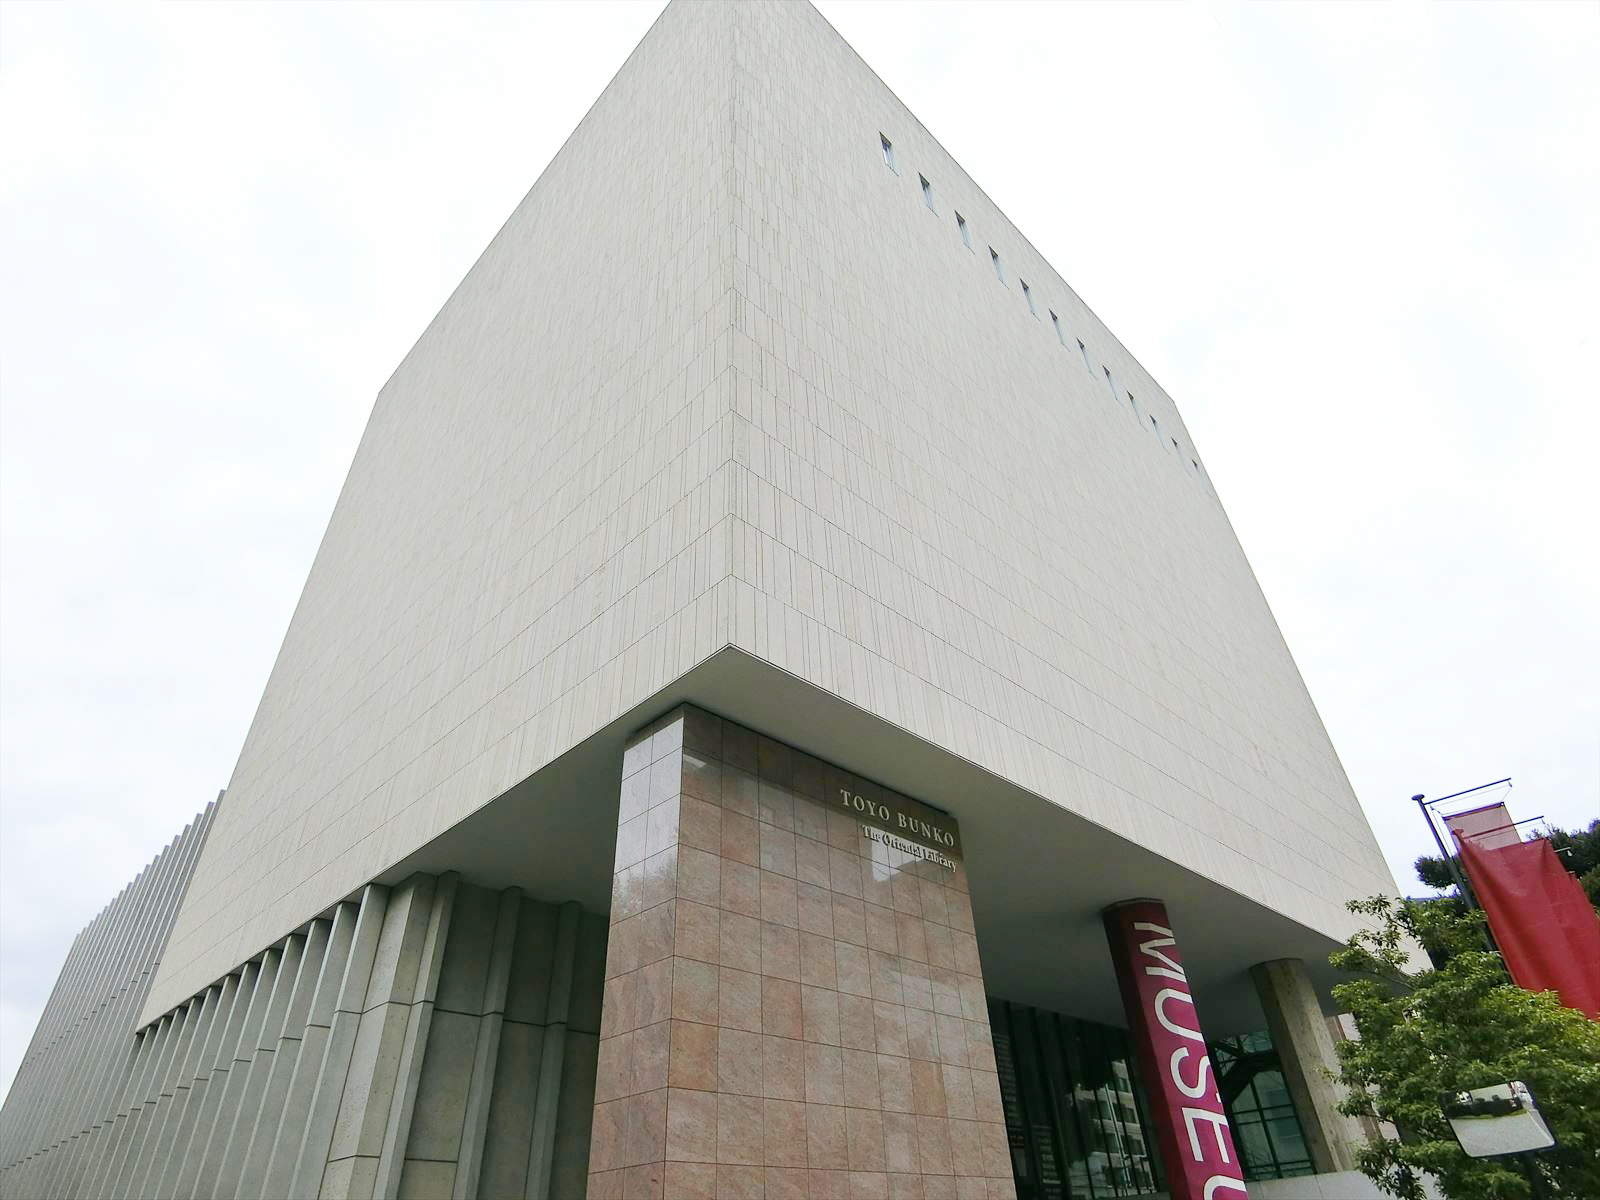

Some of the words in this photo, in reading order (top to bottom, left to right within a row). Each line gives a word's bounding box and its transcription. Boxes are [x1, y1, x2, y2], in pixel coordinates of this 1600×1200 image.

[840, 789, 890, 821] TOYO
[897, 812, 954, 847] BUNKO
[862, 825, 881, 842] The
[882, 832, 925, 860] Oriental
[925, 847, 957, 872] Library
